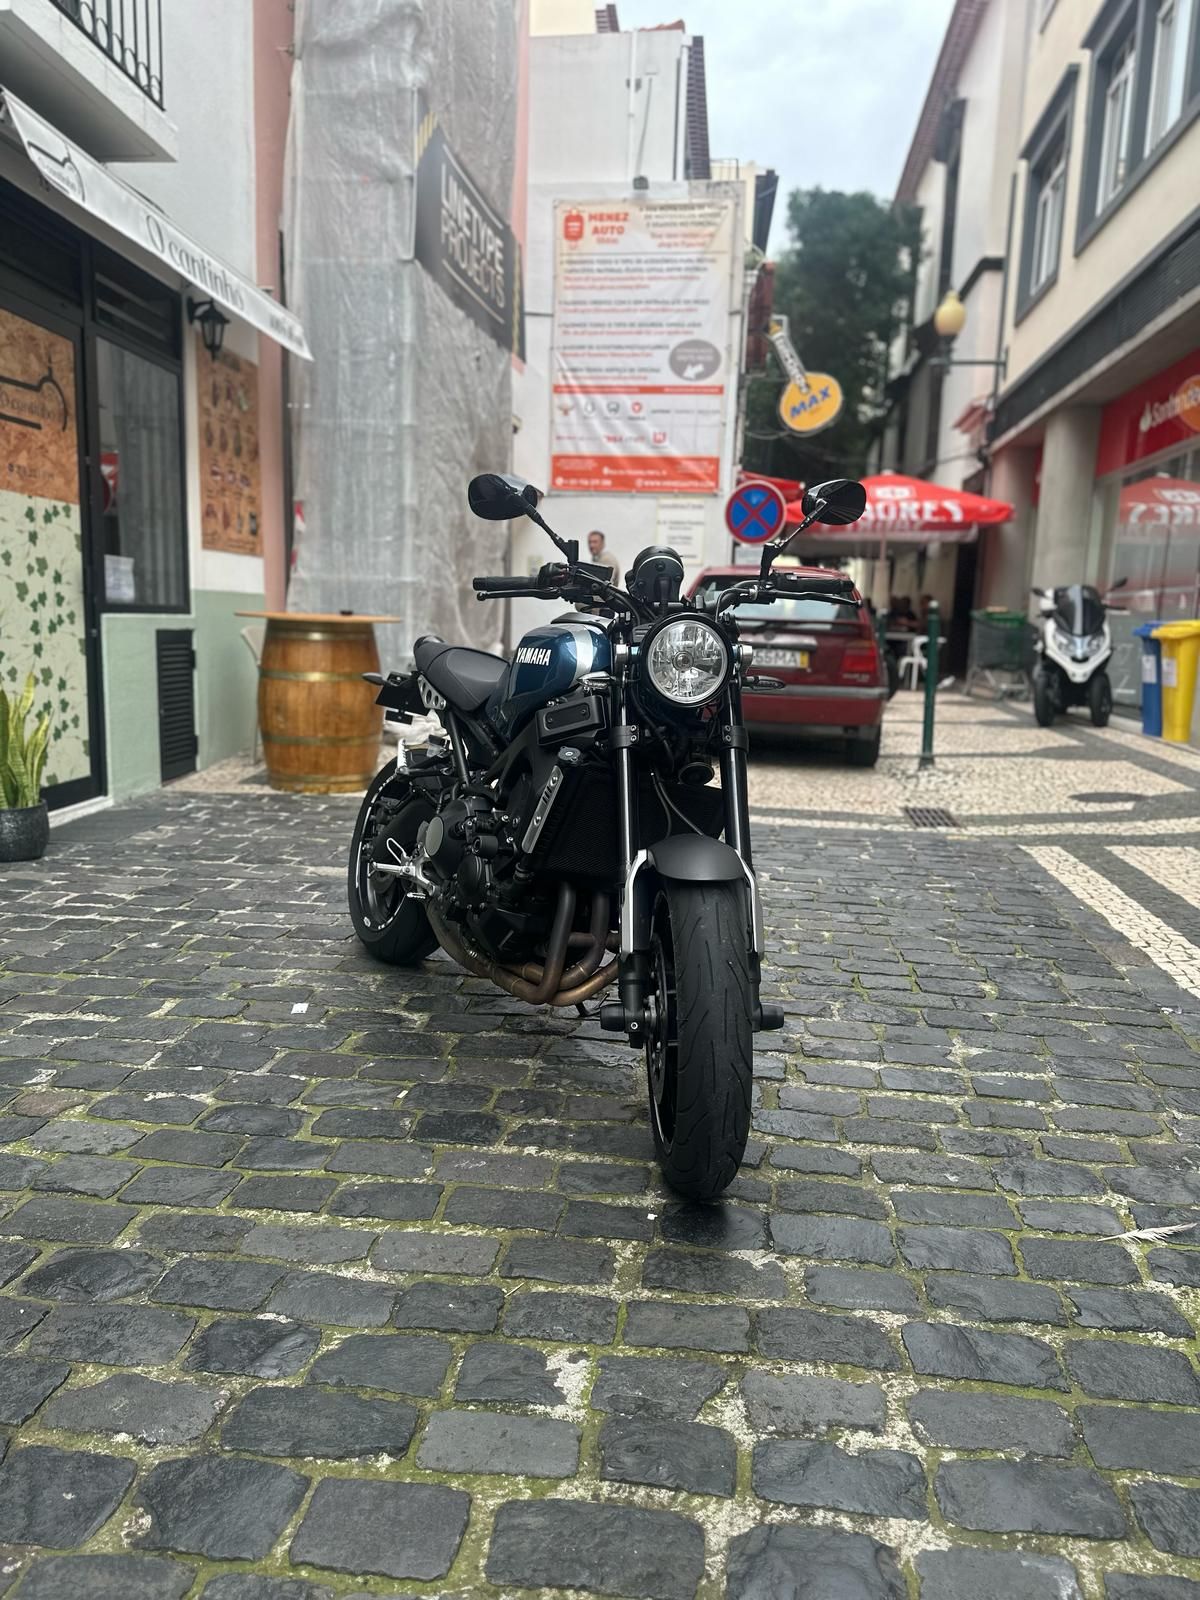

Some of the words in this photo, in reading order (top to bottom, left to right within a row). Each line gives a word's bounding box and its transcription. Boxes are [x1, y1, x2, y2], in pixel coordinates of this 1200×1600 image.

[592, 225, 625, 235] AUTO
[147, 214, 165, 254] O
[168, 241, 245, 312] cantinho
[441, 207, 505, 308] PROJECTS
[790, 384, 832, 418] MAX
[516, 647, 552, 666] YAMAHA
